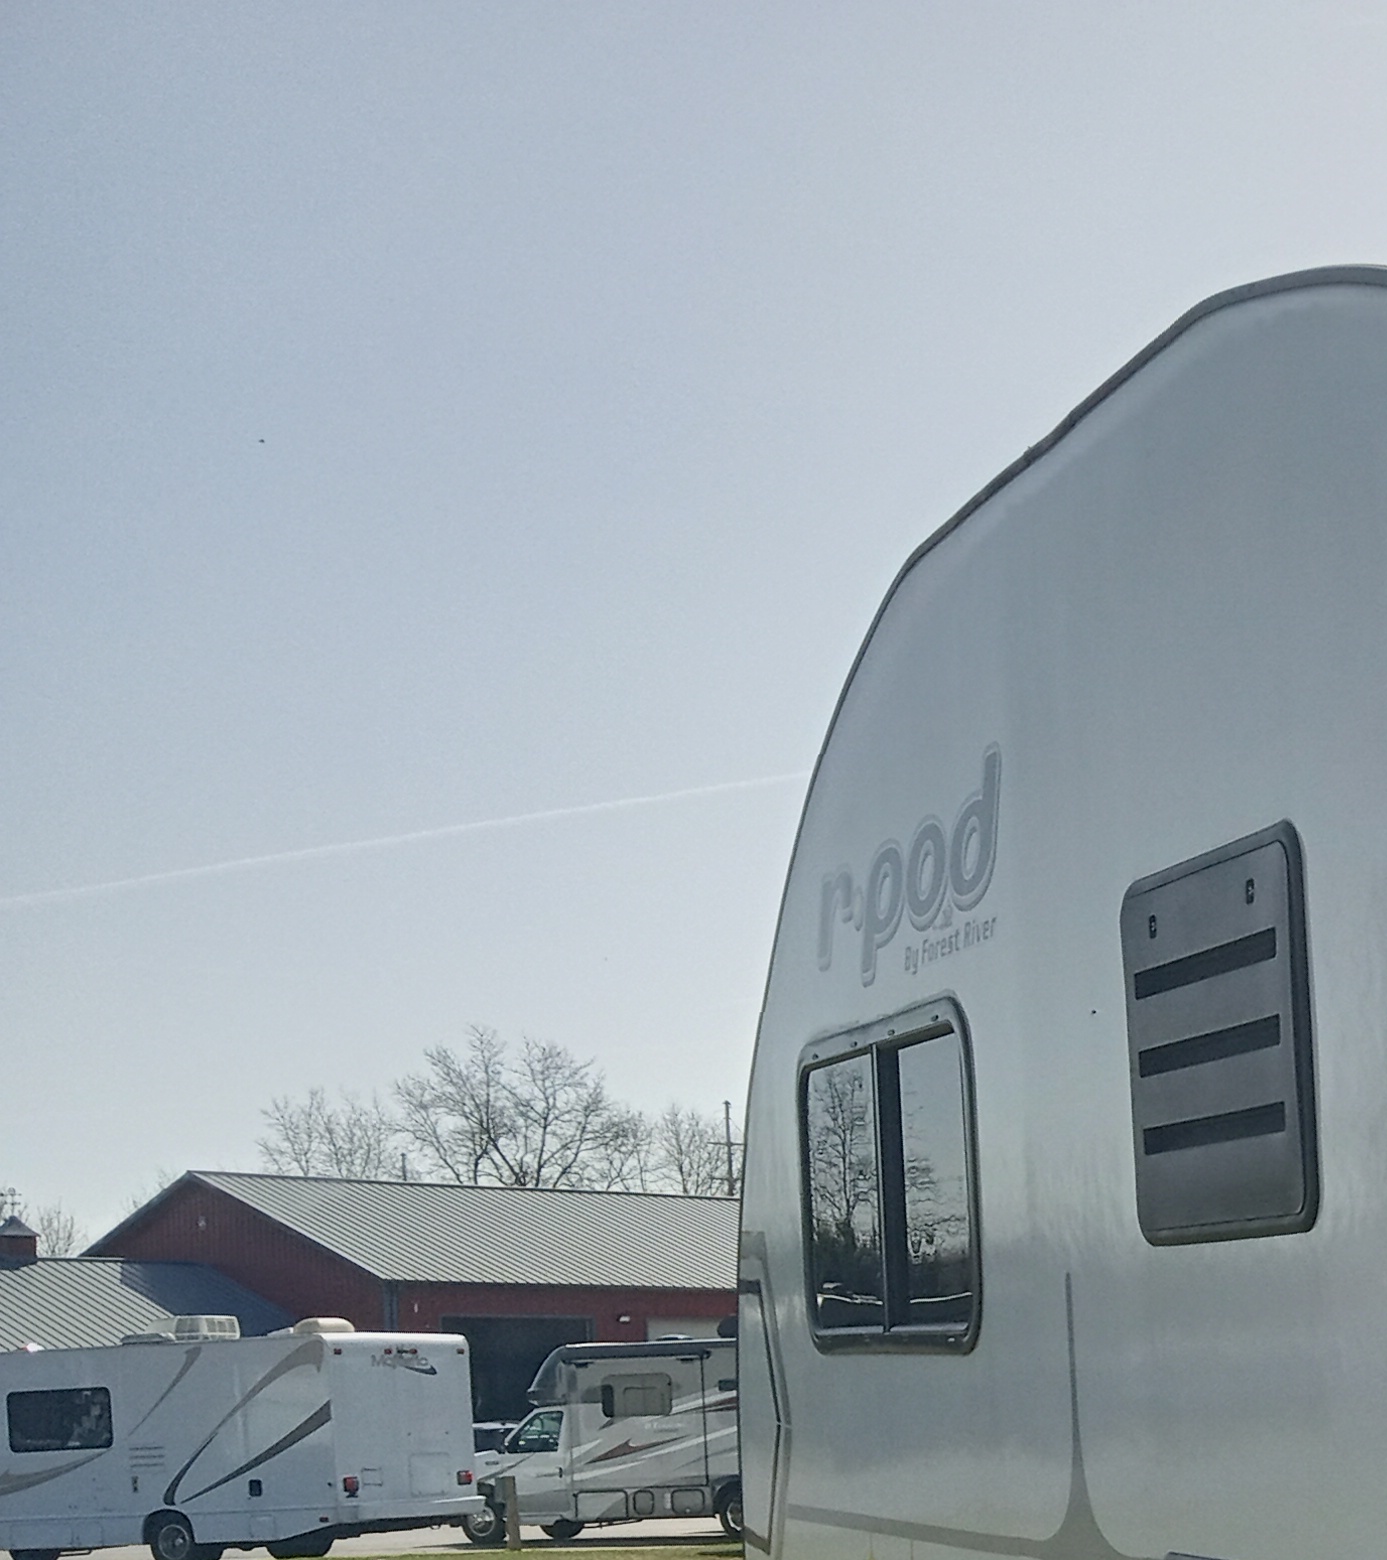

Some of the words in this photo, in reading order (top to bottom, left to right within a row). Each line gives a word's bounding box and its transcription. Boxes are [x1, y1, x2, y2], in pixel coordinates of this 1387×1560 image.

[904, 946, 919, 976] By
[921, 929, 961, 966] Forest
[963, 916, 998, 949] River
